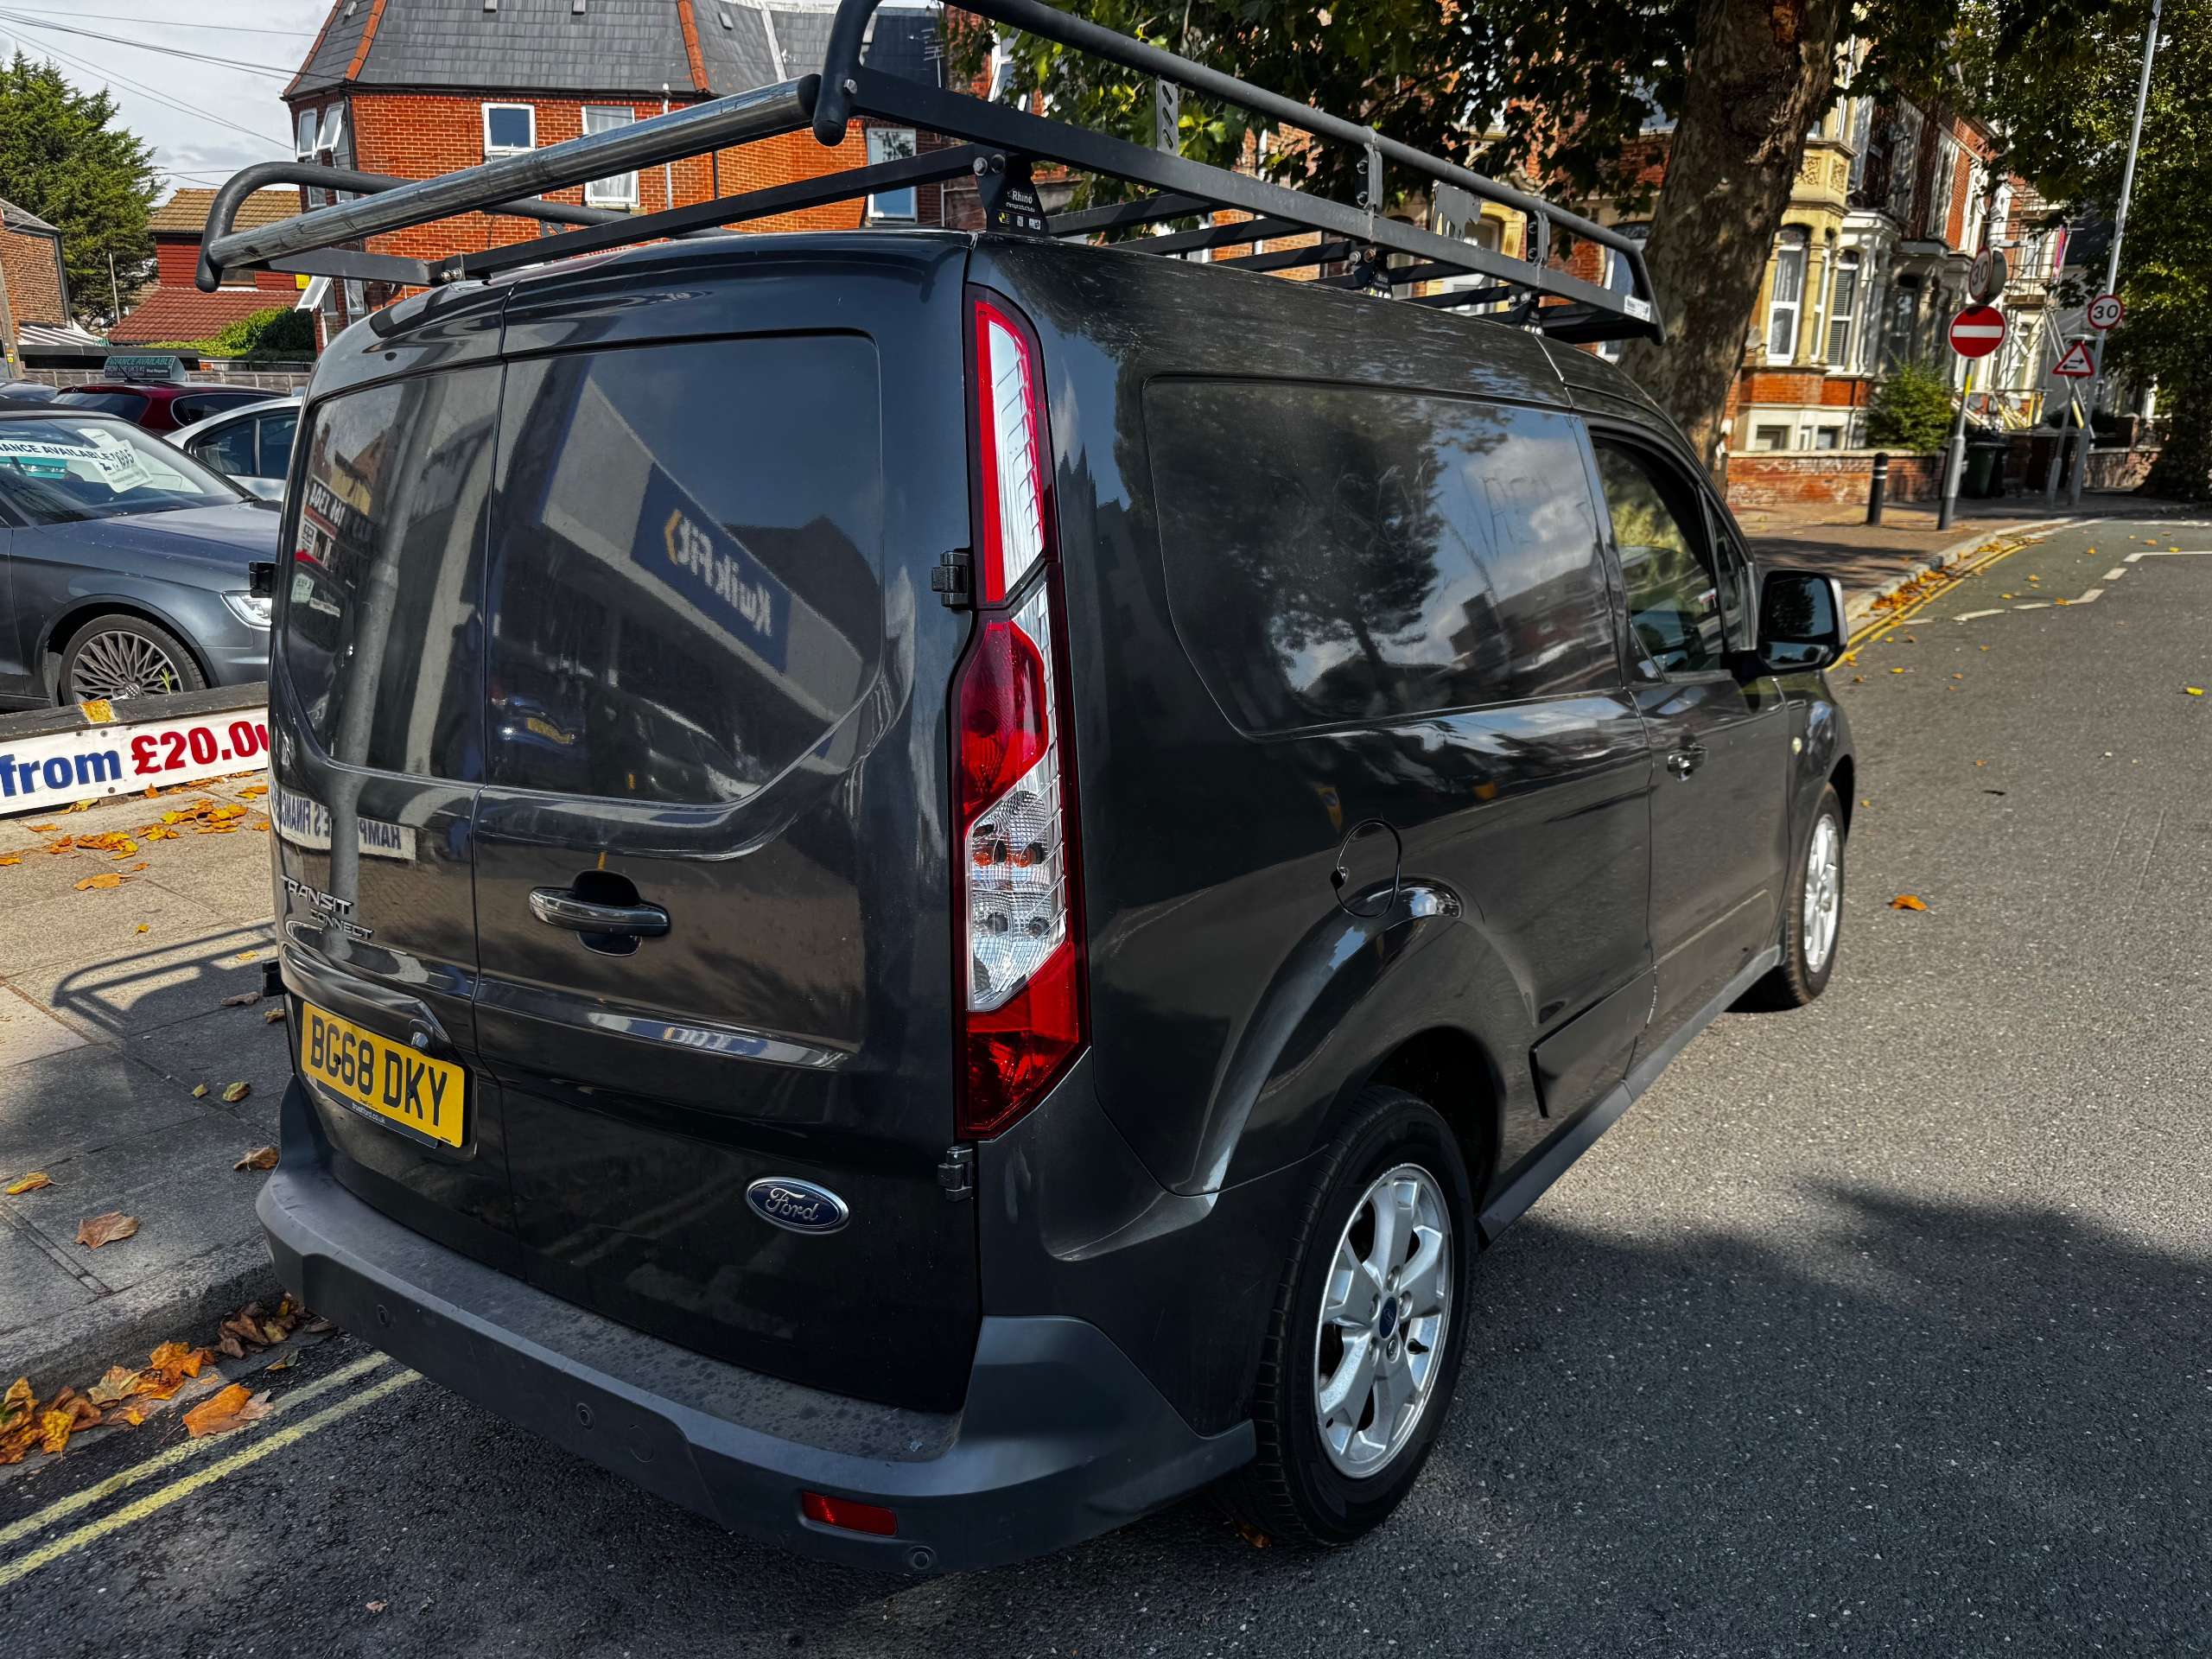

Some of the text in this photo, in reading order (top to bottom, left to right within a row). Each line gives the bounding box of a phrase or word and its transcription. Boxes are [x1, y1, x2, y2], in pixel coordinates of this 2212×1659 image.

[1012, 190, 1033, 204] Rhino
[1972, 261, 1988, 285] 30
[2093, 304, 2119, 320] 30
[136, 357, 173, 365] AVAILABLE
[41, 446, 114, 461] AVAILABLE
[0, 747, 123, 797] from
[281, 874, 353, 916] TRANSIT
[310, 908, 373, 940] CONNECT
[310, 1014, 448, 1128] BG68 DKY
[765, 1187, 819, 1222] Ford
